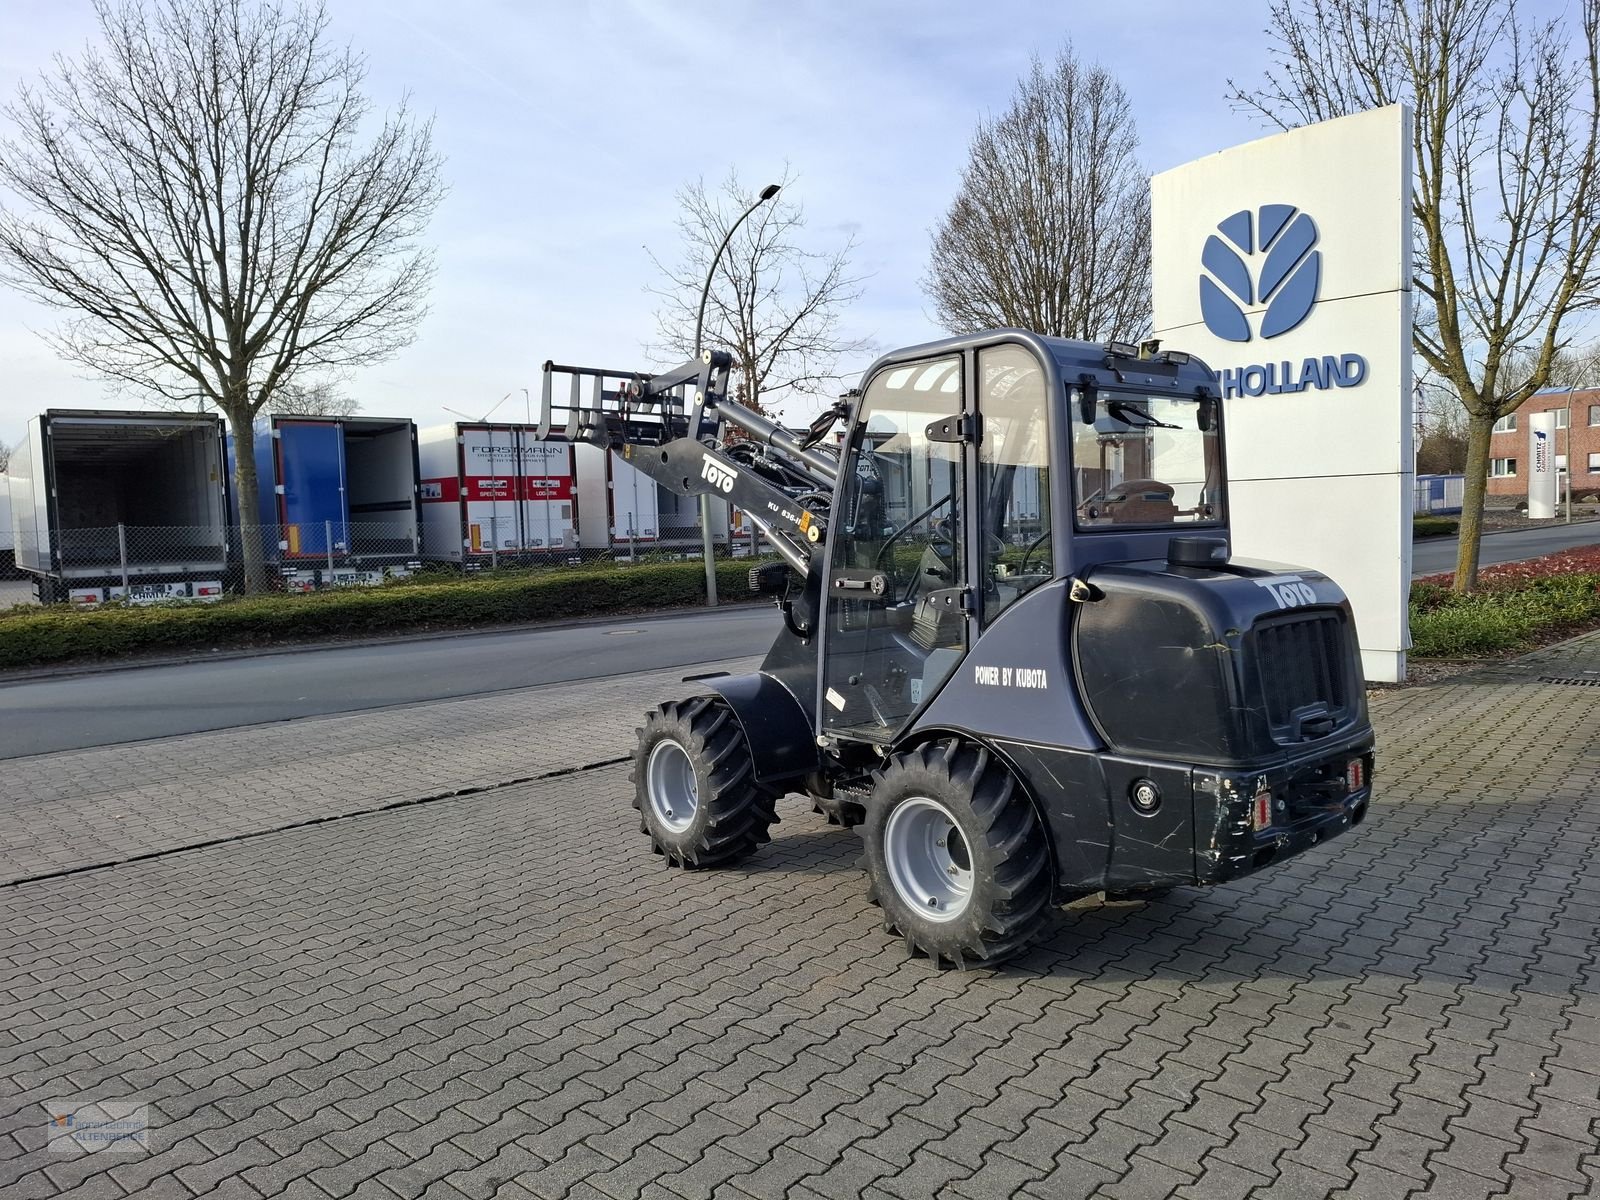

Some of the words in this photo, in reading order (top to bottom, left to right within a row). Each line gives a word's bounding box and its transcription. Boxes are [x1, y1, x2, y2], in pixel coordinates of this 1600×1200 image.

[1223, 352, 1366, 400] HOLLAND
[701, 452, 739, 493] TOYO
[767, 501, 779, 512] KU
[1254, 575, 1318, 609] TOYO
[975, 665, 1000, 686] POWER
[1002, 666, 1012, 687] BY
[1015, 667, 1048, 689] KUBOTA
